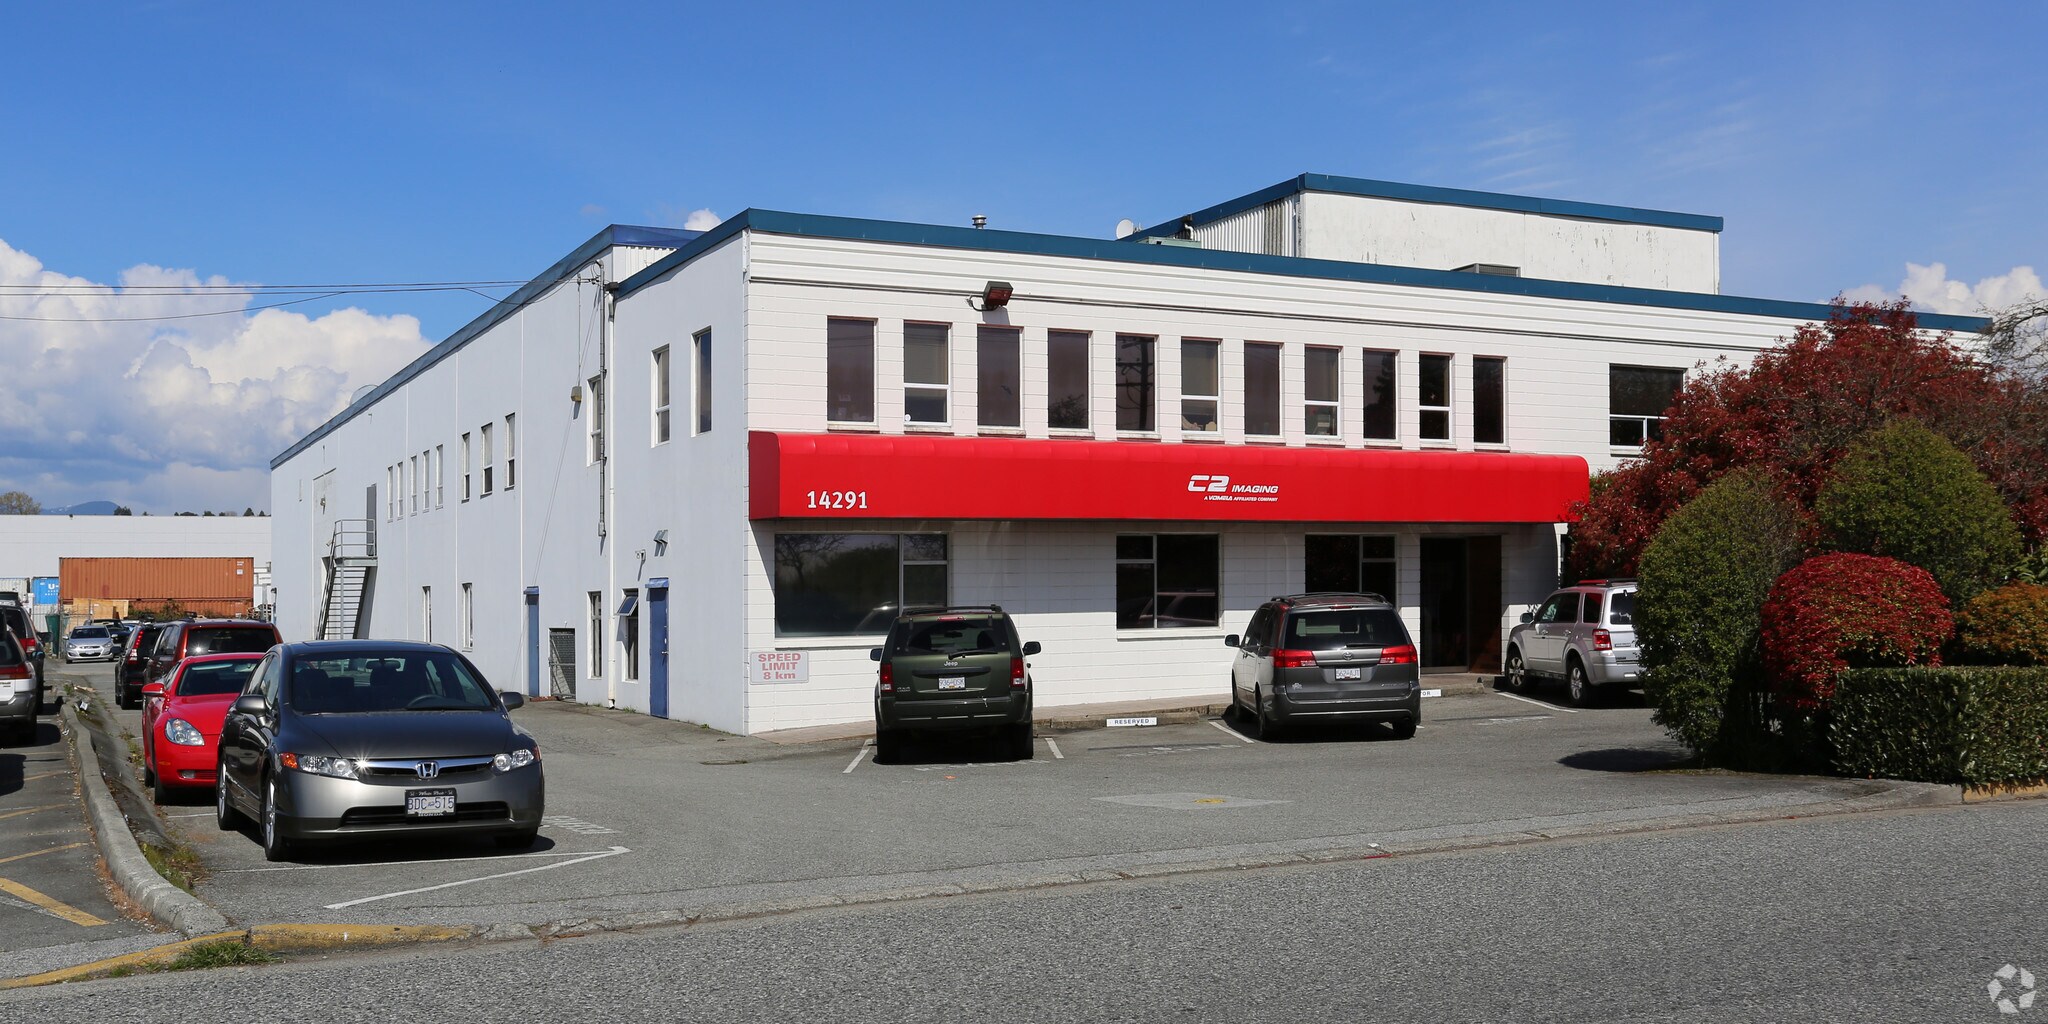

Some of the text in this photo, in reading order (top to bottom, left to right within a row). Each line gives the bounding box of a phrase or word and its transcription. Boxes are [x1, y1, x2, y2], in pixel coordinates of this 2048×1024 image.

[1187, 474, 1279, 494] C2 IMAGING
[807, 490, 868, 510] 14291
[758, 652, 802, 663] SPEED
[761, 661, 798, 671] LIMIT
[763, 671, 796, 680] 8 km
